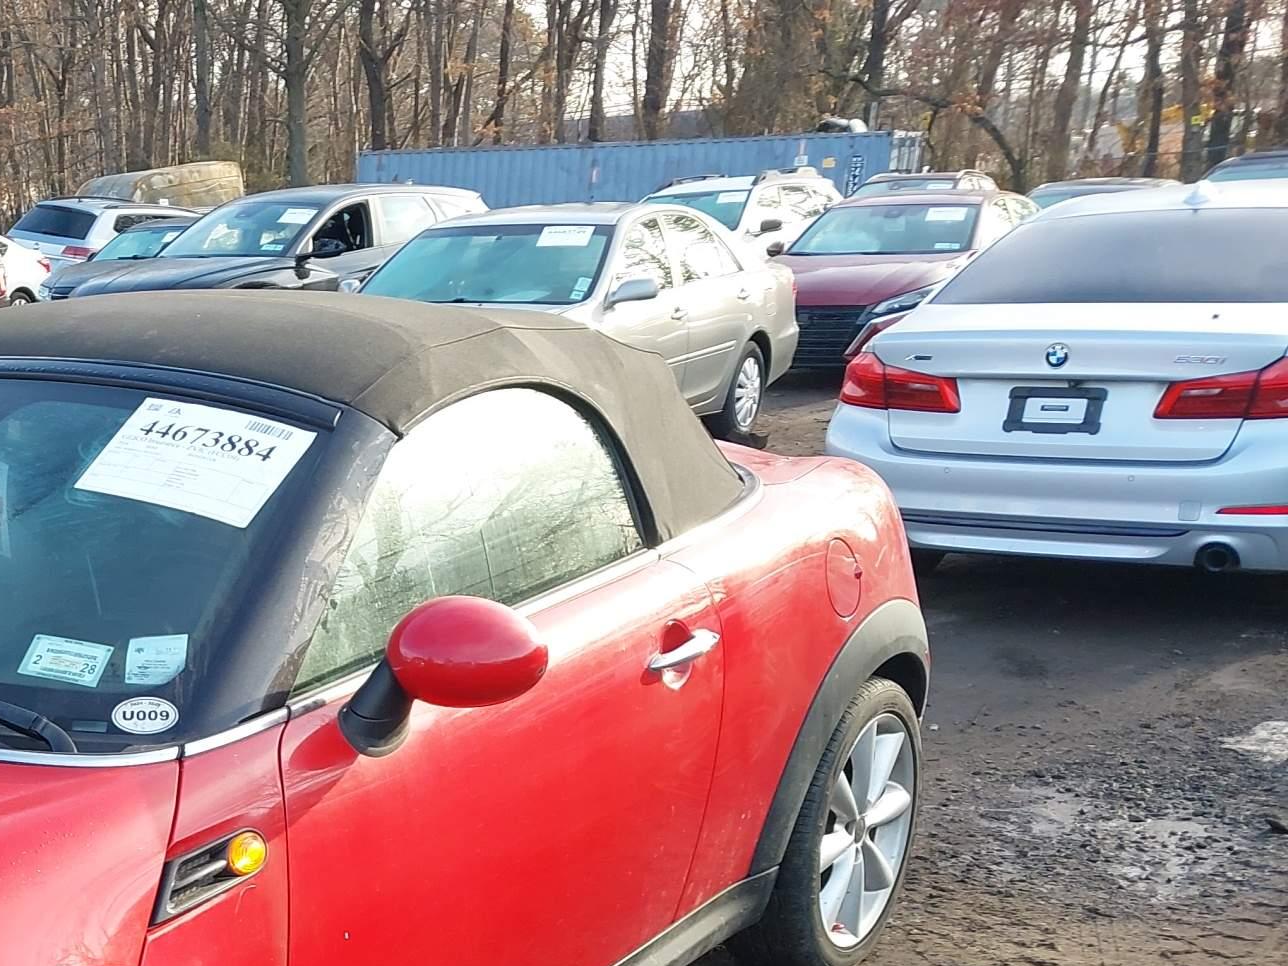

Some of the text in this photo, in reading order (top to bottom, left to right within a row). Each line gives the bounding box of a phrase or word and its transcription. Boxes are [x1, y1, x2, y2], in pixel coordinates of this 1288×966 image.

[139, 420, 278, 462] 44673884
[32, 654, 43, 665] 2
[79, 662, 97, 675] 28
[122, 710, 170, 721] U009
